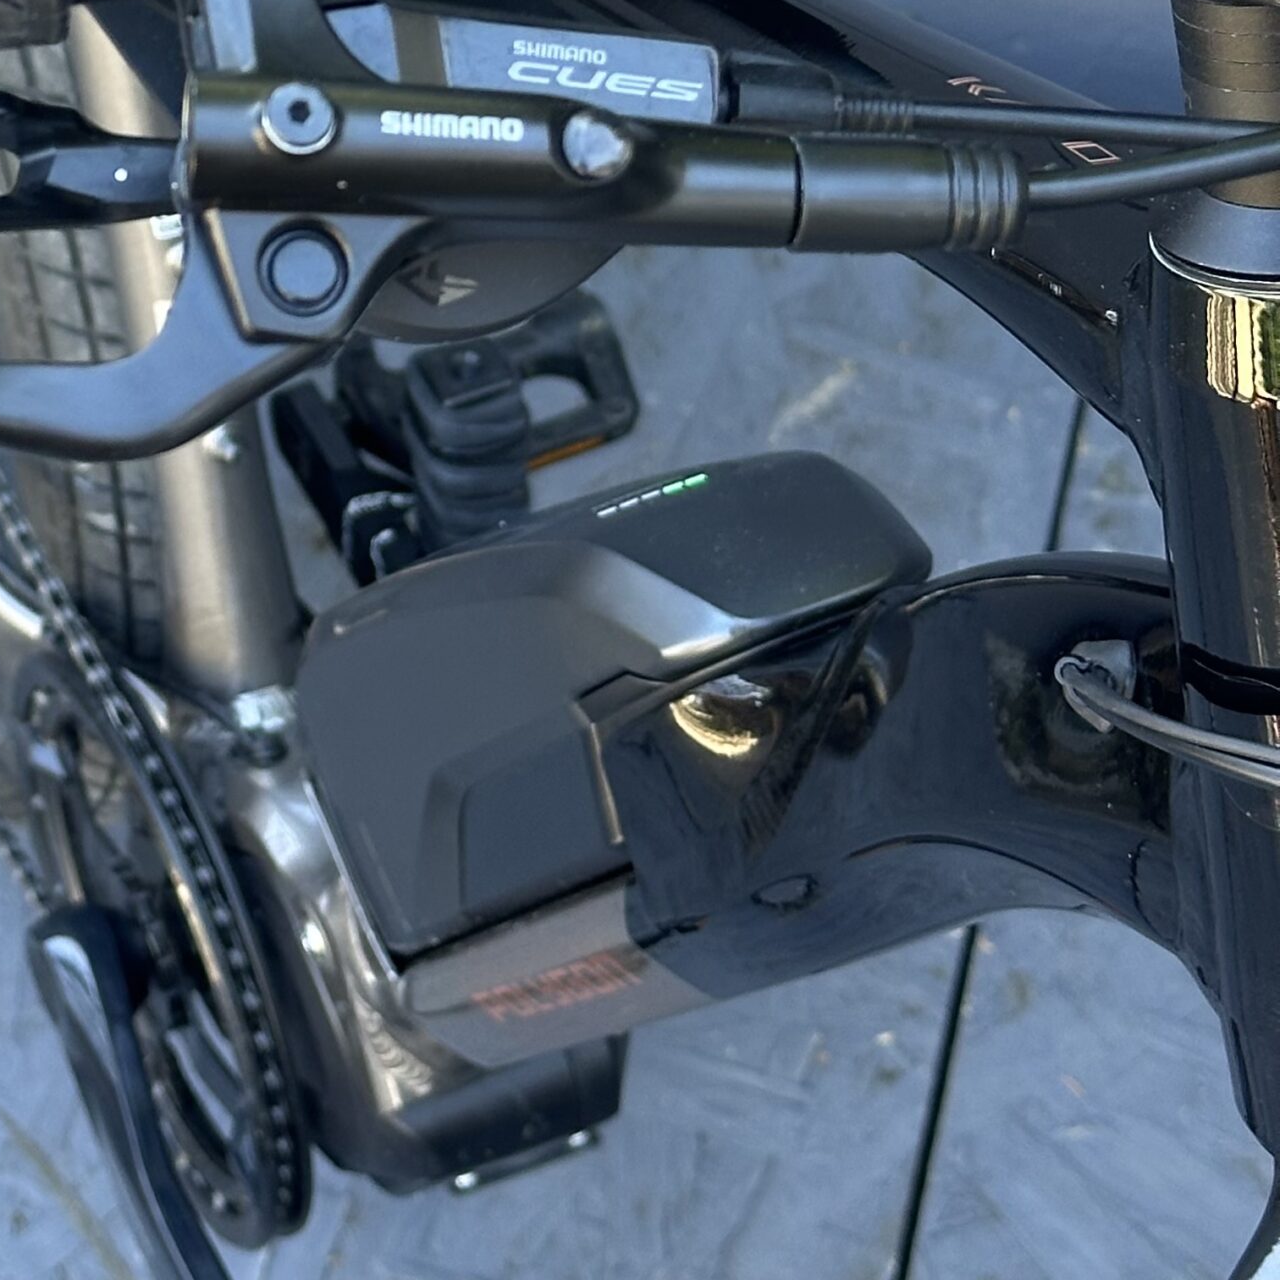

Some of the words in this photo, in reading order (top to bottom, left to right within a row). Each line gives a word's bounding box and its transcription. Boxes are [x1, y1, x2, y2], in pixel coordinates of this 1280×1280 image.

[513, 40, 607, 65] SHIMANO
[507, 61, 703, 101] CUES
[381, 110, 524, 142] SHIMANO
